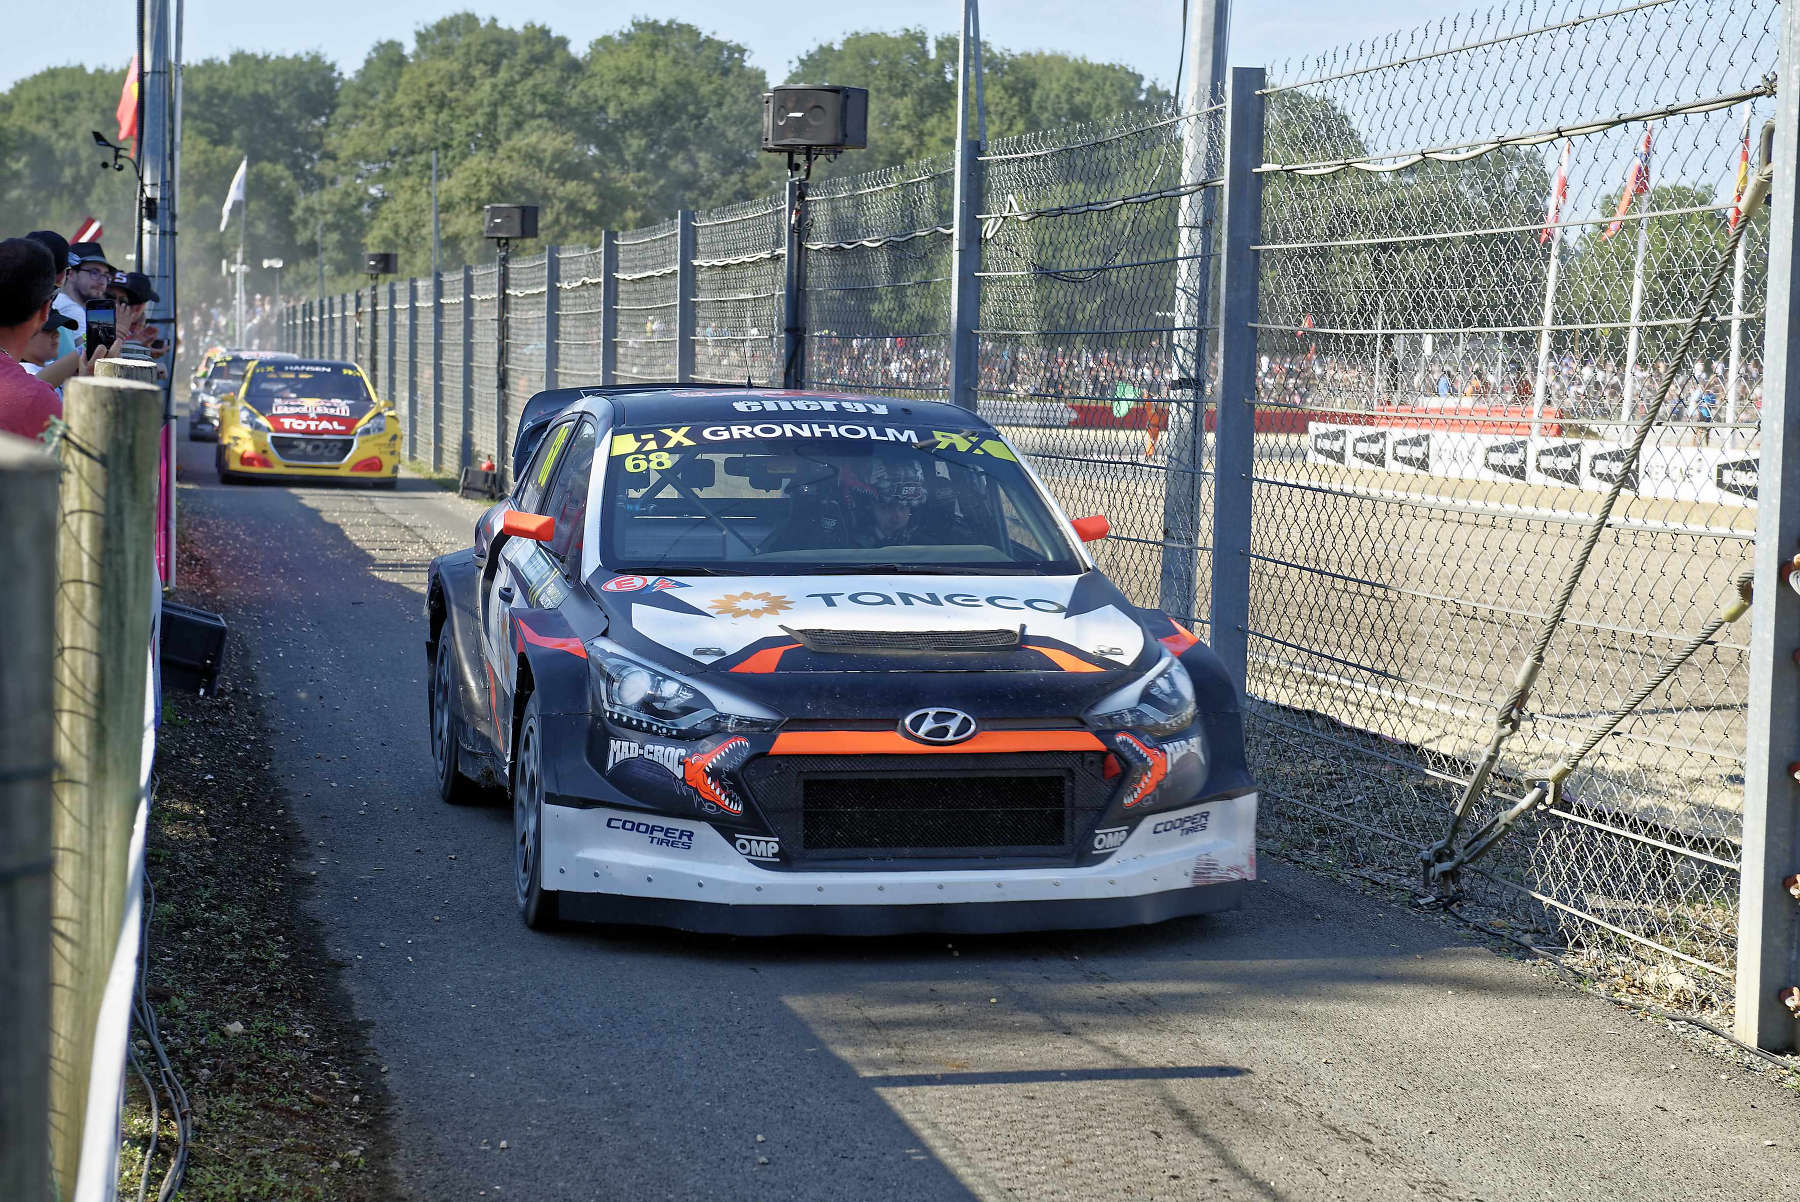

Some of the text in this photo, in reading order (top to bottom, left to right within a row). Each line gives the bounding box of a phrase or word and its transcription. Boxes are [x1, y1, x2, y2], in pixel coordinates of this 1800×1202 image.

[114, 271, 128, 284] S
[732, 399, 889, 415] energy
[279, 417, 347, 431] TOTAL
[702, 423, 919, 444] GRONHOLM
[288, 440, 343, 456] 208
[624, 451, 673, 473] 68
[605, 736, 687, 780] MAD-CROC
[605, 817, 695, 842] COOPER
[1152, 810, 1210, 835] COOPER
[1180, 822, 1208, 837] TIRES
[648, 835, 692, 850] TIRES
[734, 837, 780, 858] OMP
[1093, 829, 1129, 850] OMP
